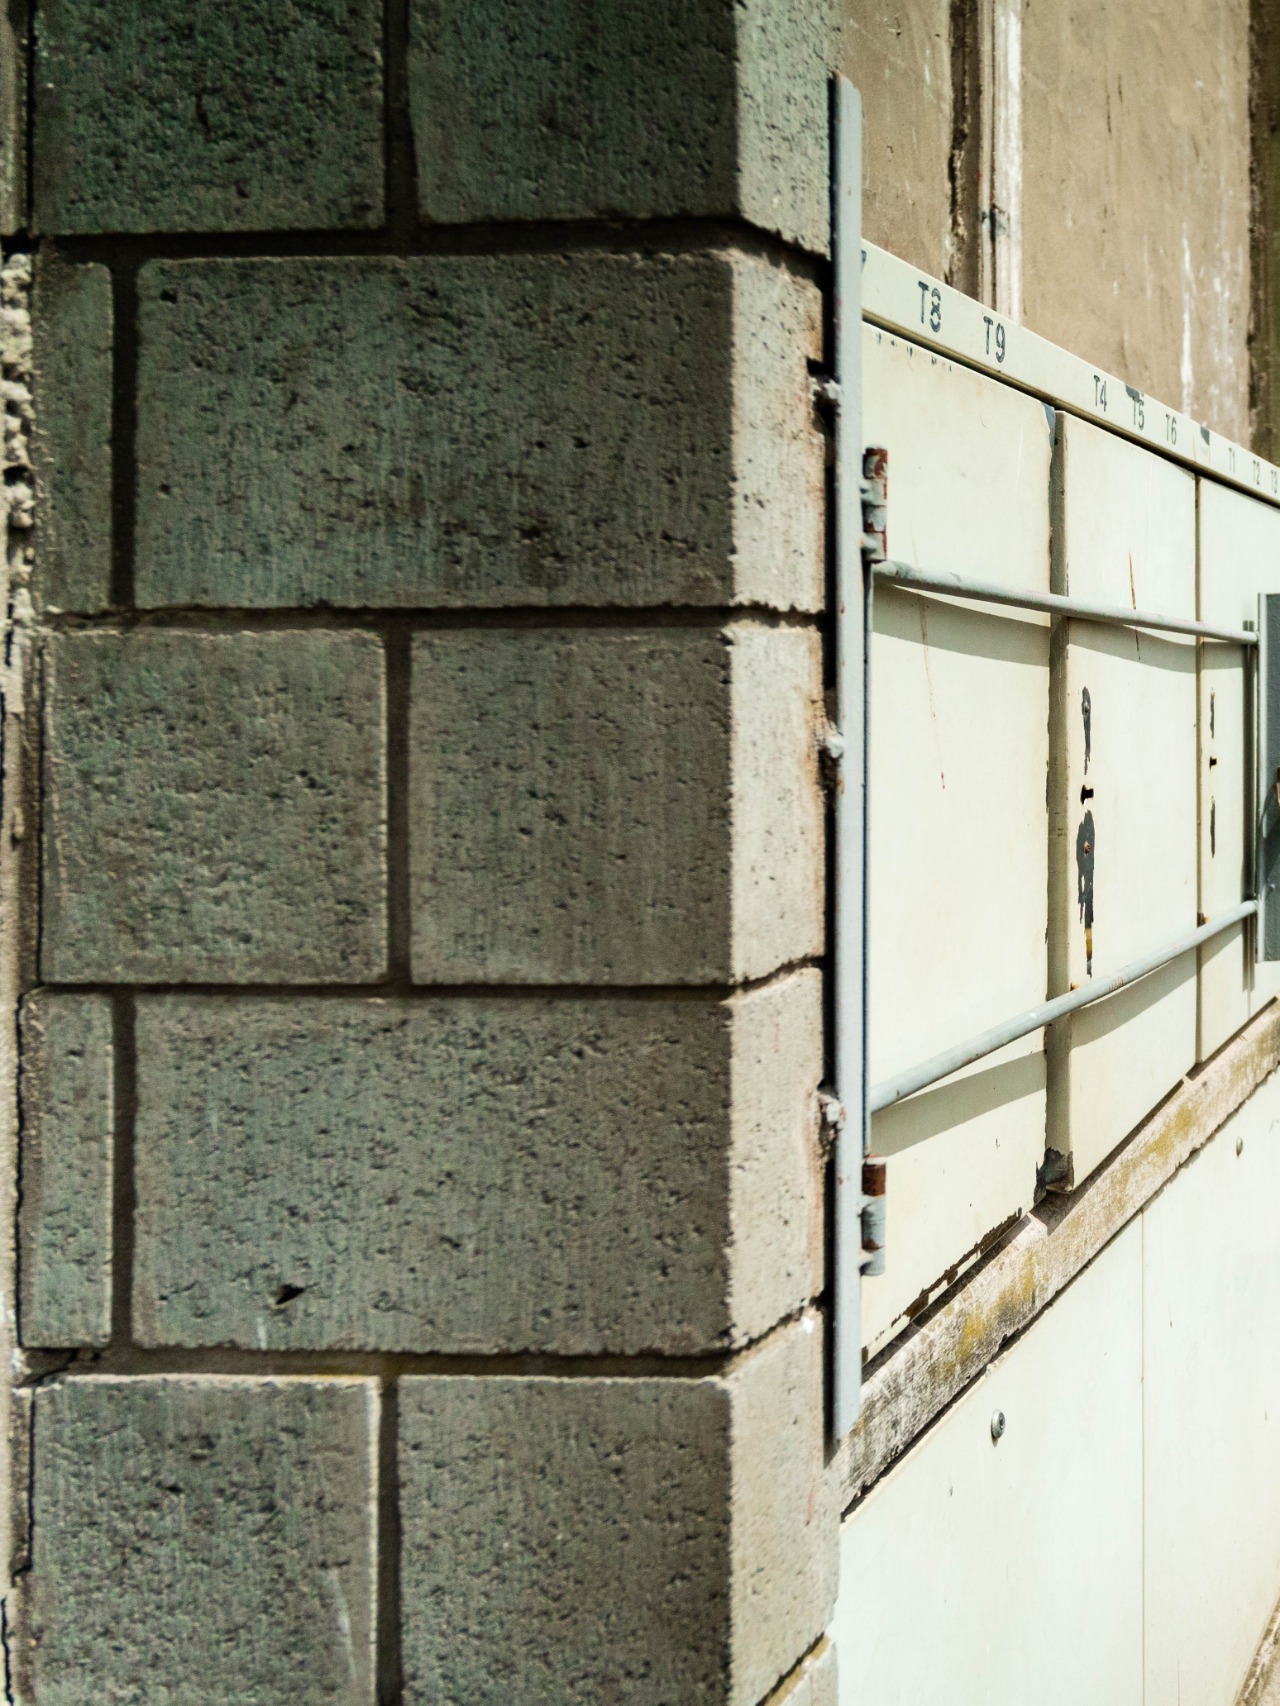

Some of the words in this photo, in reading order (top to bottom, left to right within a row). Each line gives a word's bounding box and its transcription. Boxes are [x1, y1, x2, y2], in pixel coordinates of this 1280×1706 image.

[918, 281, 941, 332] T8
[983, 316, 1005, 363] T9
[1093, 374, 1107, 413] T4
[1132, 395, 1145, 431] T5
[1165, 413, 1177, 445] T6
[1228, 447, 1236, 474] T1
[1252, 459, 1261, 485] T2
[1270, 469, 1278, 495] T3
